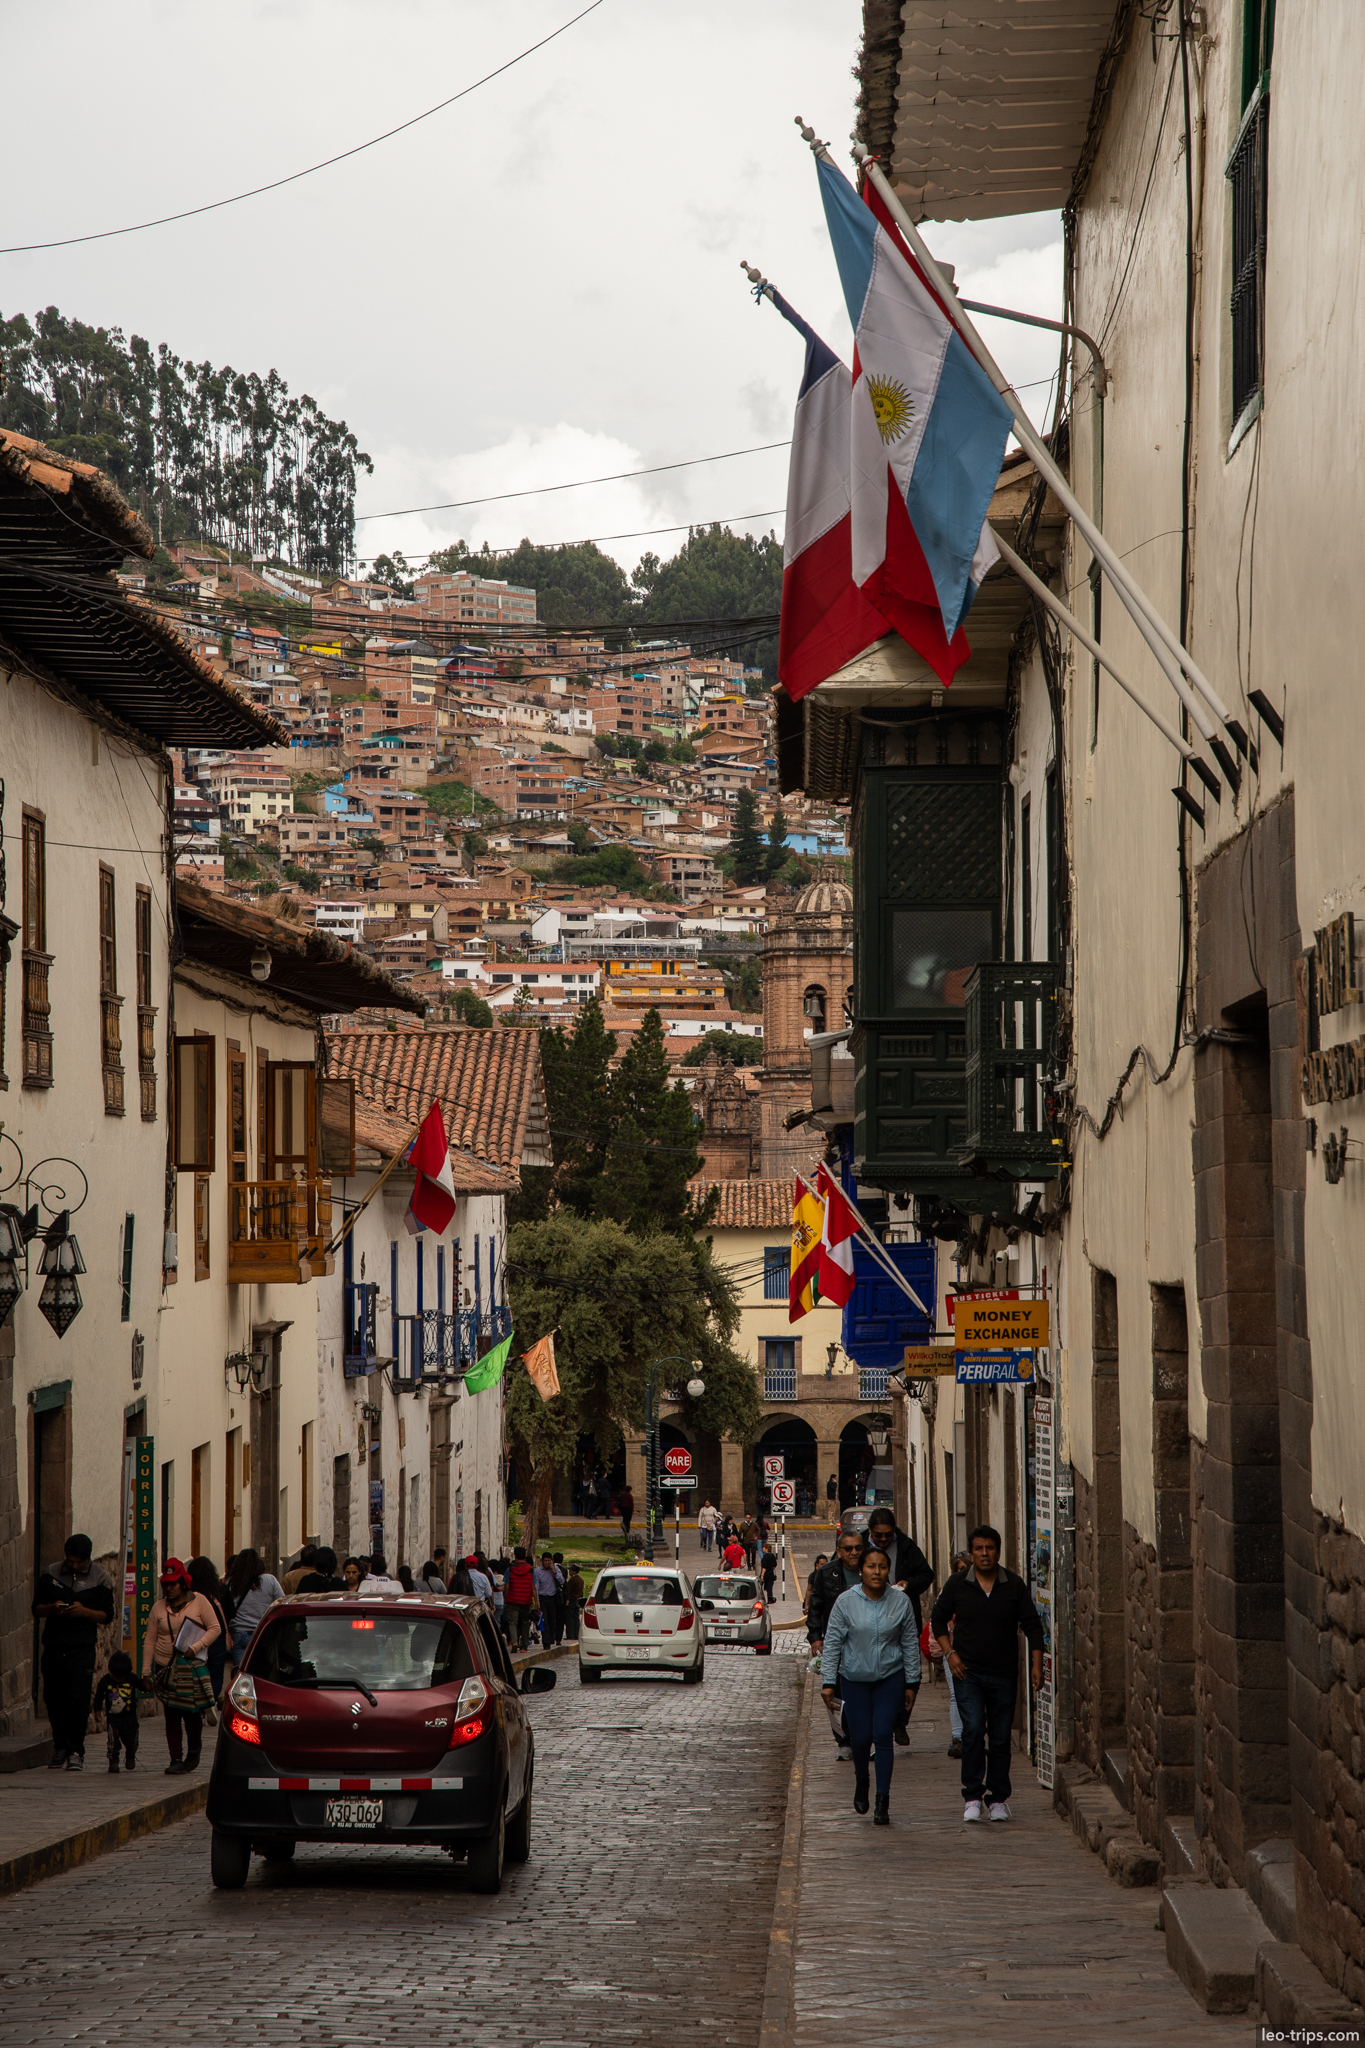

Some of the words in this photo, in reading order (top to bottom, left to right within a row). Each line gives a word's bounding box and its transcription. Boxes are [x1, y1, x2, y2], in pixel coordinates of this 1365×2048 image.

[952, 1295, 972, 1303] BUS
[974, 1290, 1010, 1300] TICKET
[973, 1310, 1033, 1322] MONEY
[964, 1327, 1040, 1340] EXCHANGE
[957, 1364, 1018, 1380] PERURAIL
[1036, 1412, 1050, 1423] TICKET
[666, 1456, 690, 1466] PARE
[140, 1440, 150, 1531] TOURIST
[779, 1486, 787, 1498] E
[326, 1804, 382, 1822] X3Q-069
